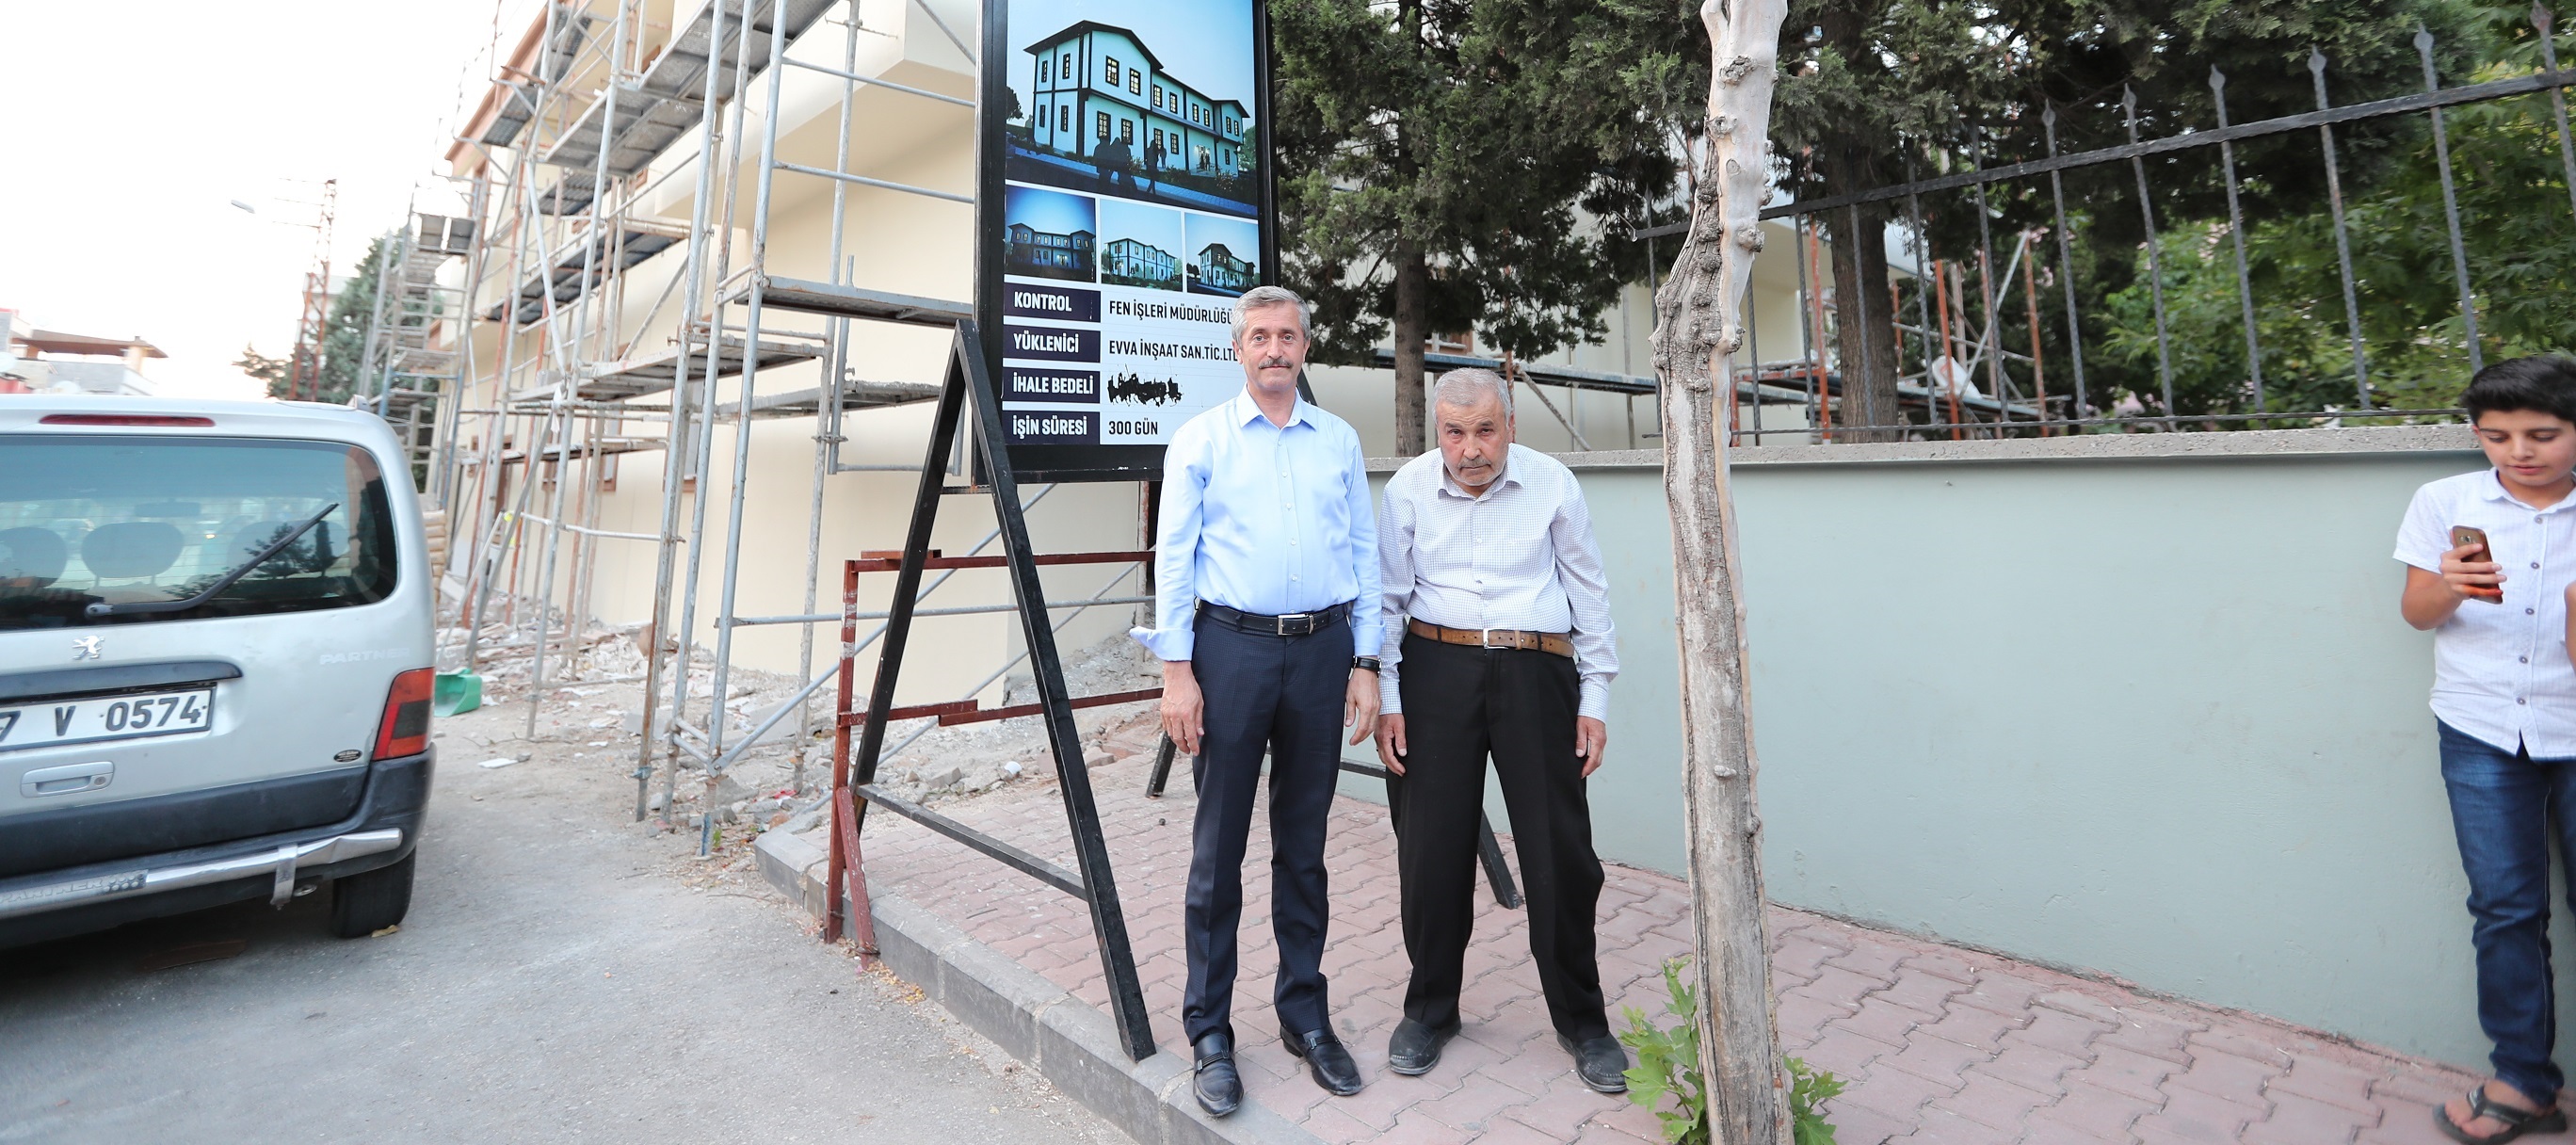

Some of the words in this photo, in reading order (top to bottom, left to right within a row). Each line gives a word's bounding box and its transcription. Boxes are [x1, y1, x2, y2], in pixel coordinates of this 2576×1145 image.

[1014, 291, 1072, 312] KONTROL
[1109, 299, 1131, 316] FEN
[1133, 298, 1167, 321] İŞLERİ
[1013, 330, 1079, 353] YÜKLENİCİ
[1109, 339, 1137, 356] EVVA
[1139, 338, 1179, 361] İNŞAAT
[1013, 371, 1050, 394] İHALE
[1051, 375, 1094, 395] BEDELİ
[1012, 414, 1039, 440] İŞİN
[1041, 414, 1087, 436] SÜRESİ
[1108, 420, 1132, 435] 300
[1135, 417, 1158, 435] GÜN
[320, 647, 411, 665] PARTNER
[55, 705, 76, 736] V
[105, 695, 201, 732] 0574
